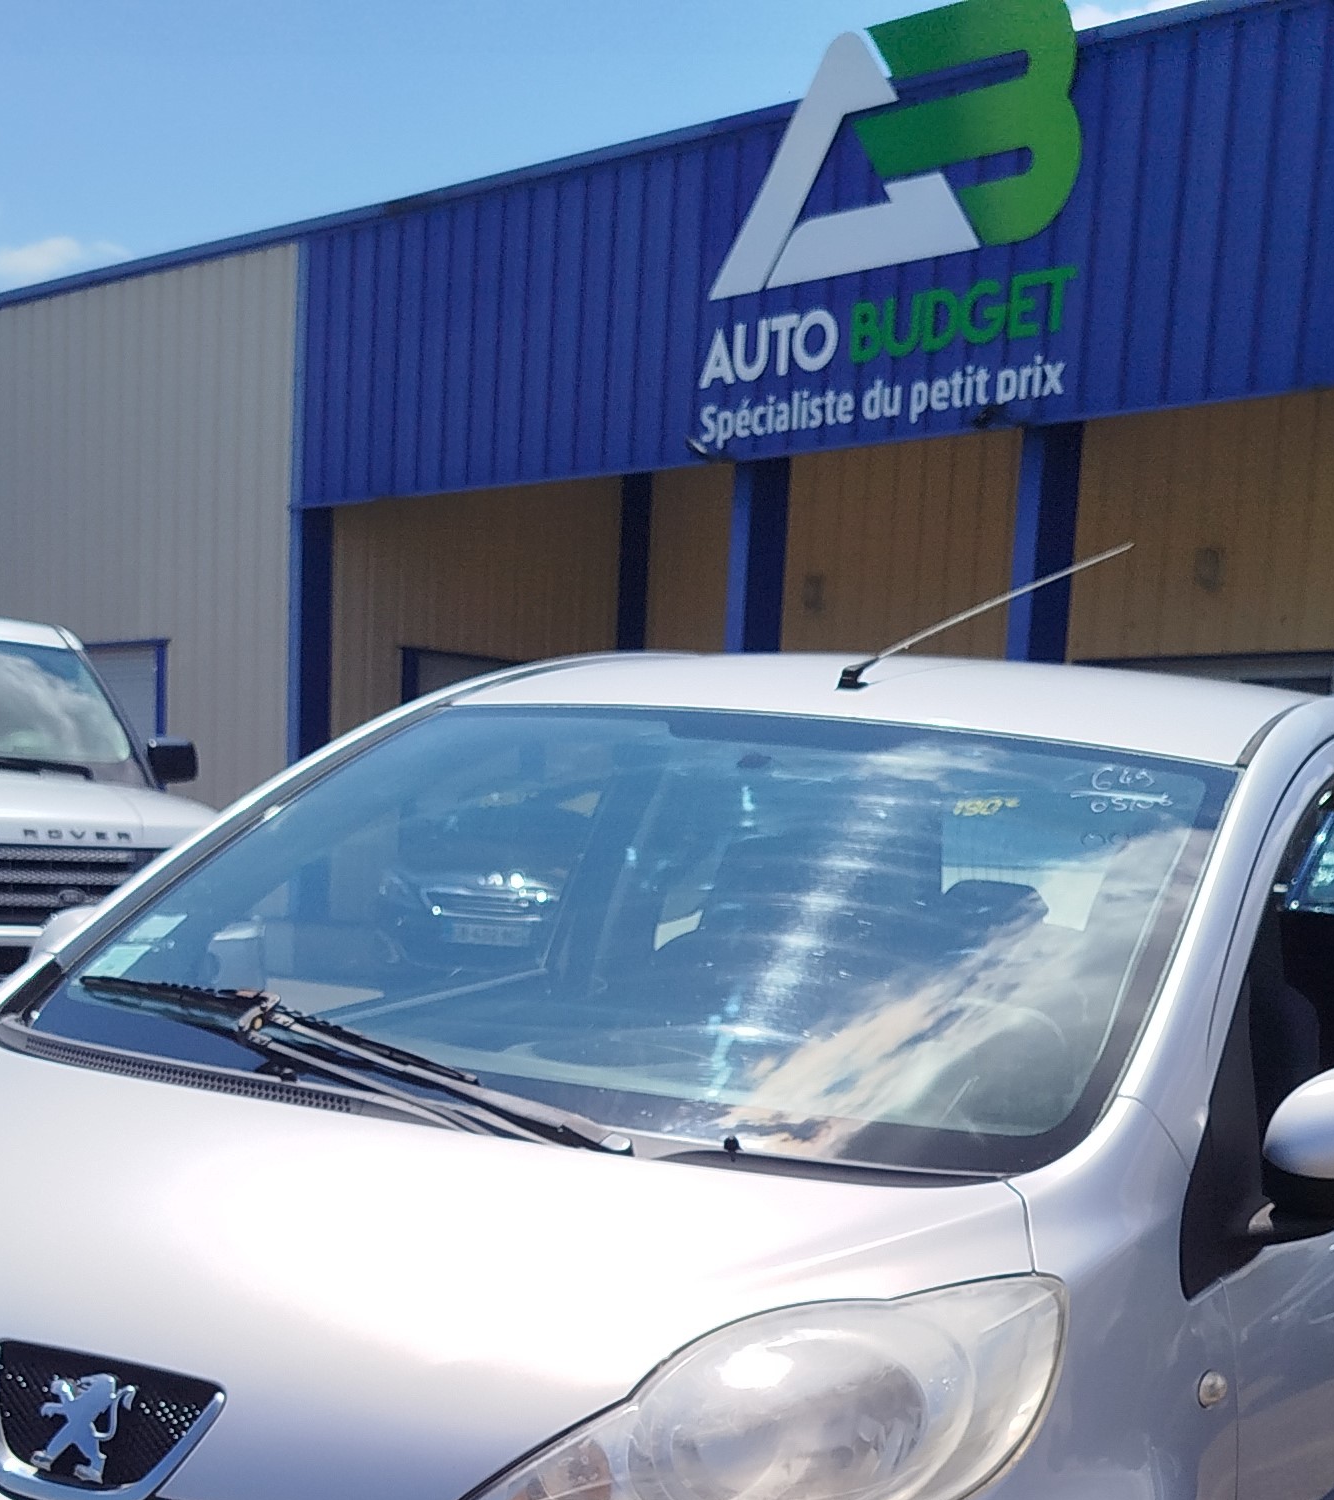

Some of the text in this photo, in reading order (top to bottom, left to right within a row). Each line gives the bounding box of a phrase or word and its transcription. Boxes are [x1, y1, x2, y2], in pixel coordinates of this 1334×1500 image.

[699, 265, 1079, 389] AUTO BUDGET
[699, 352, 1066, 450] Spécialiste du petit prix
[23, 827, 132, 842] ROVER
